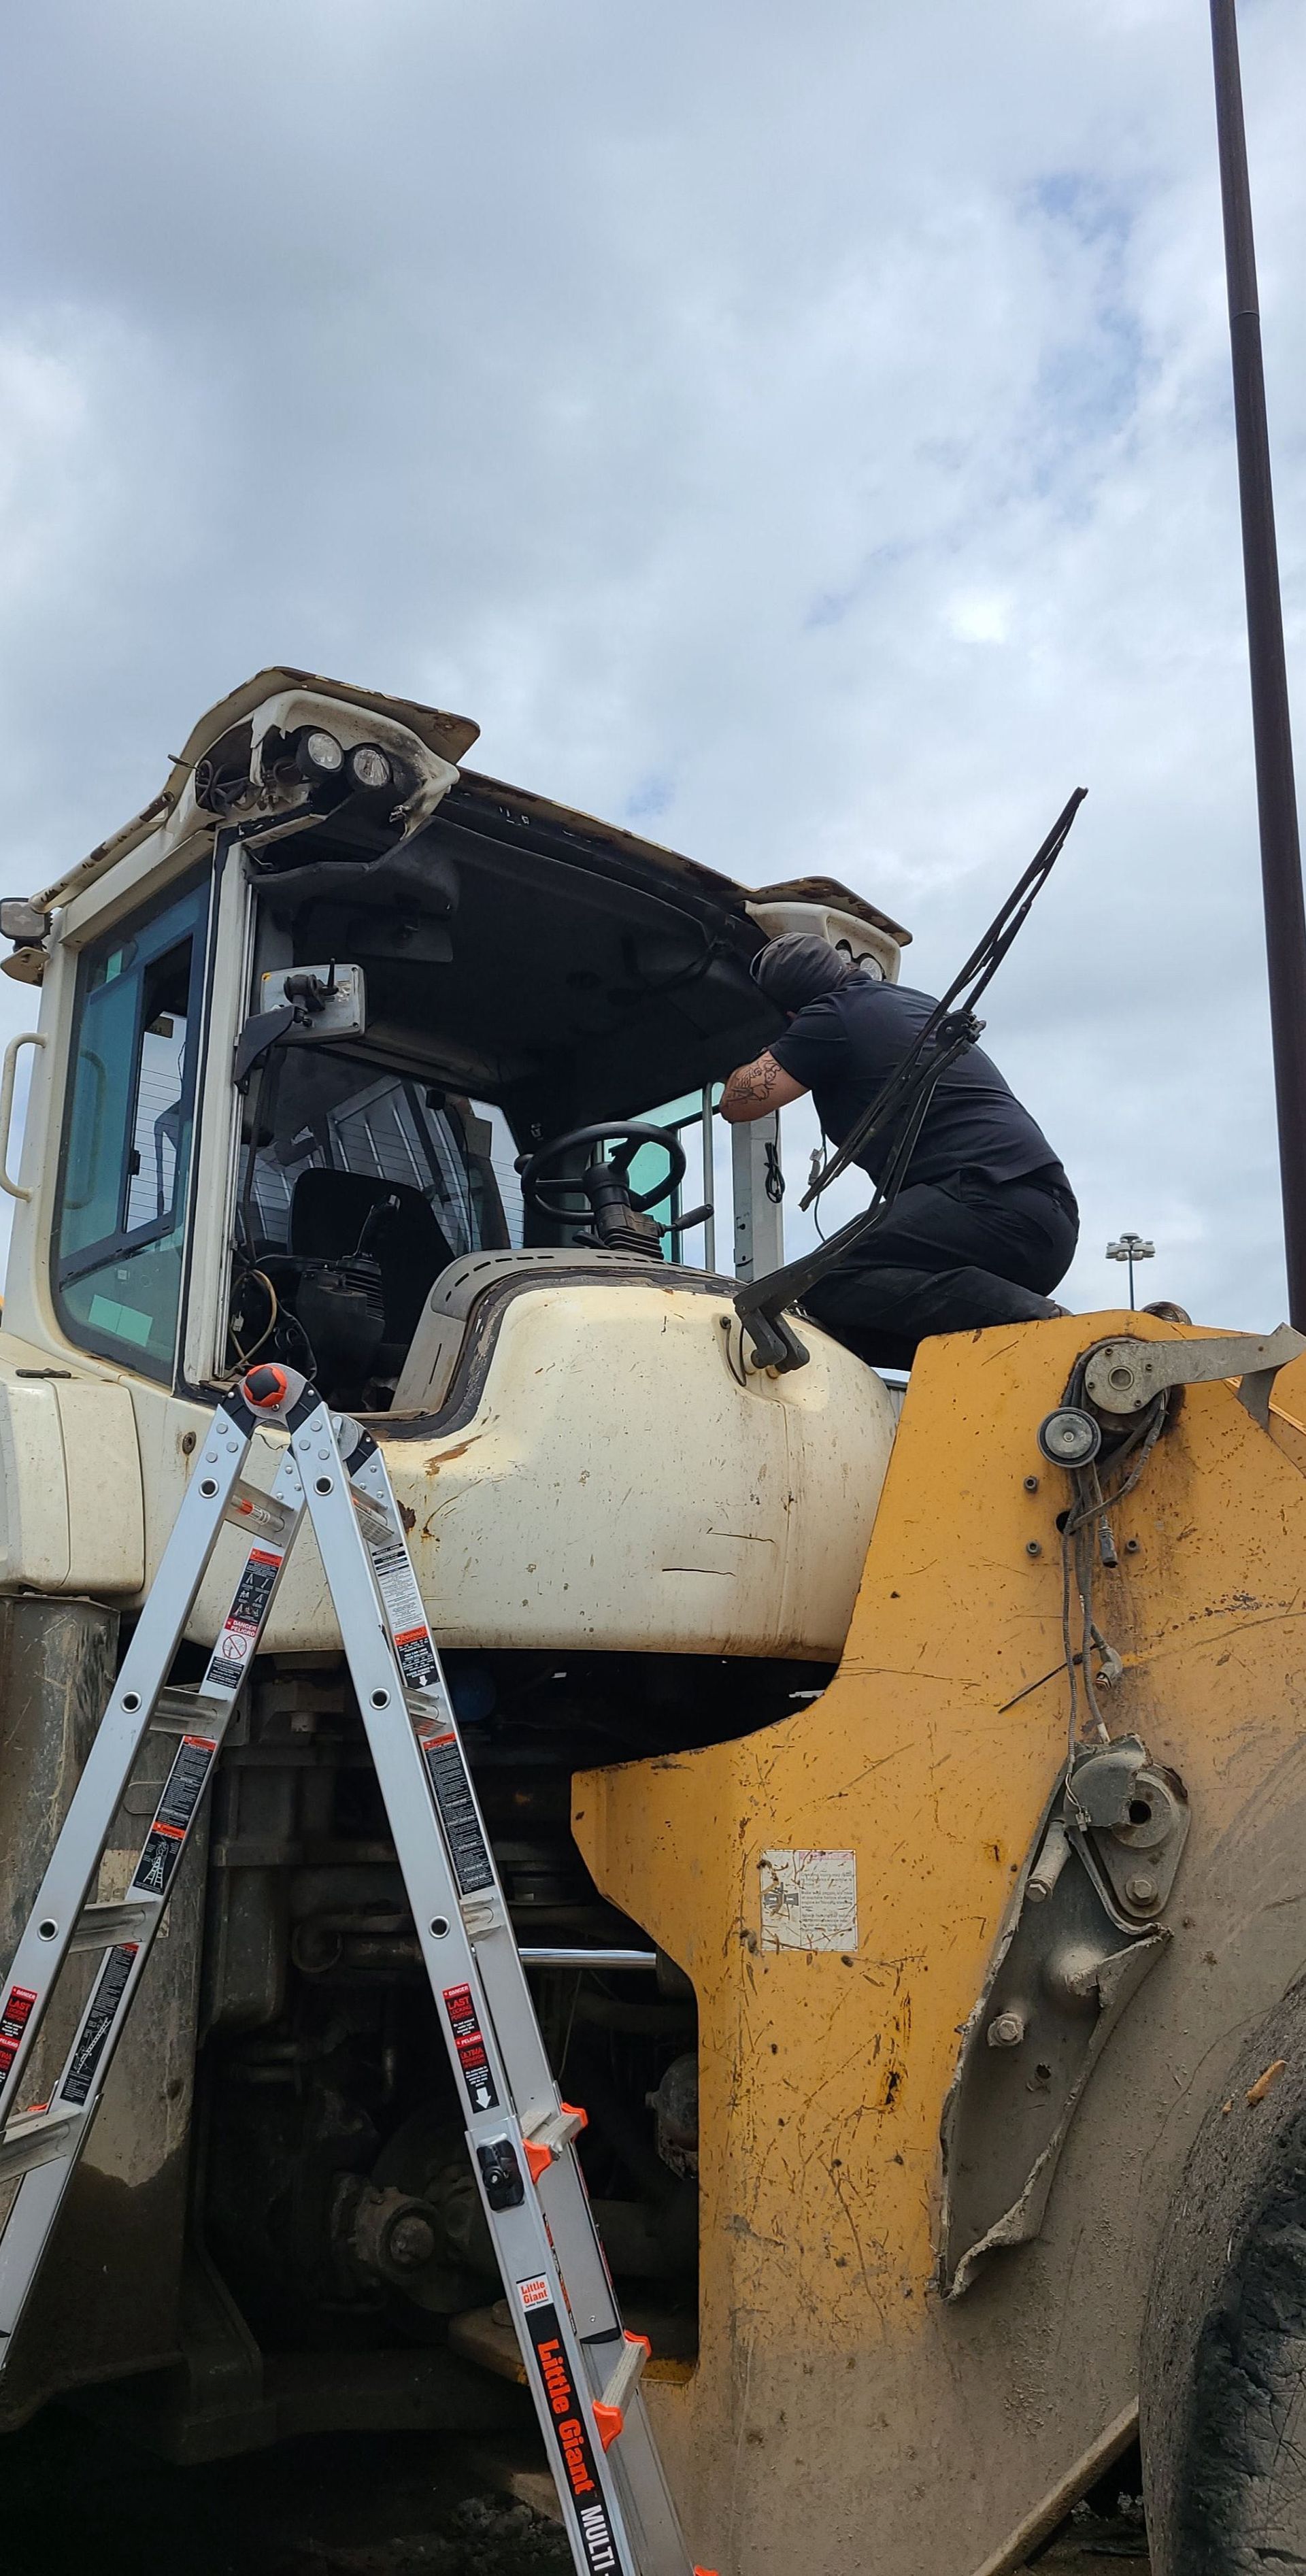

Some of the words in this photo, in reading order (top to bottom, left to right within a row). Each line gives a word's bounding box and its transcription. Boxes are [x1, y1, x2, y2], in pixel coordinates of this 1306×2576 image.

[231, 1625, 255, 1637] PELIGRO
[233, 1620, 257, 1630] DANGER
[9, 1998, 31, 2011] LAST
[447, 1996, 469, 2009] LAST
[520, 2281, 546, 2295] Little
[523, 2289, 548, 2304] Giant
[537, 2339, 571, 2414] Little
[558, 2418, 596, 2495] Giant
[580, 2505, 616, 2571] MULTI
